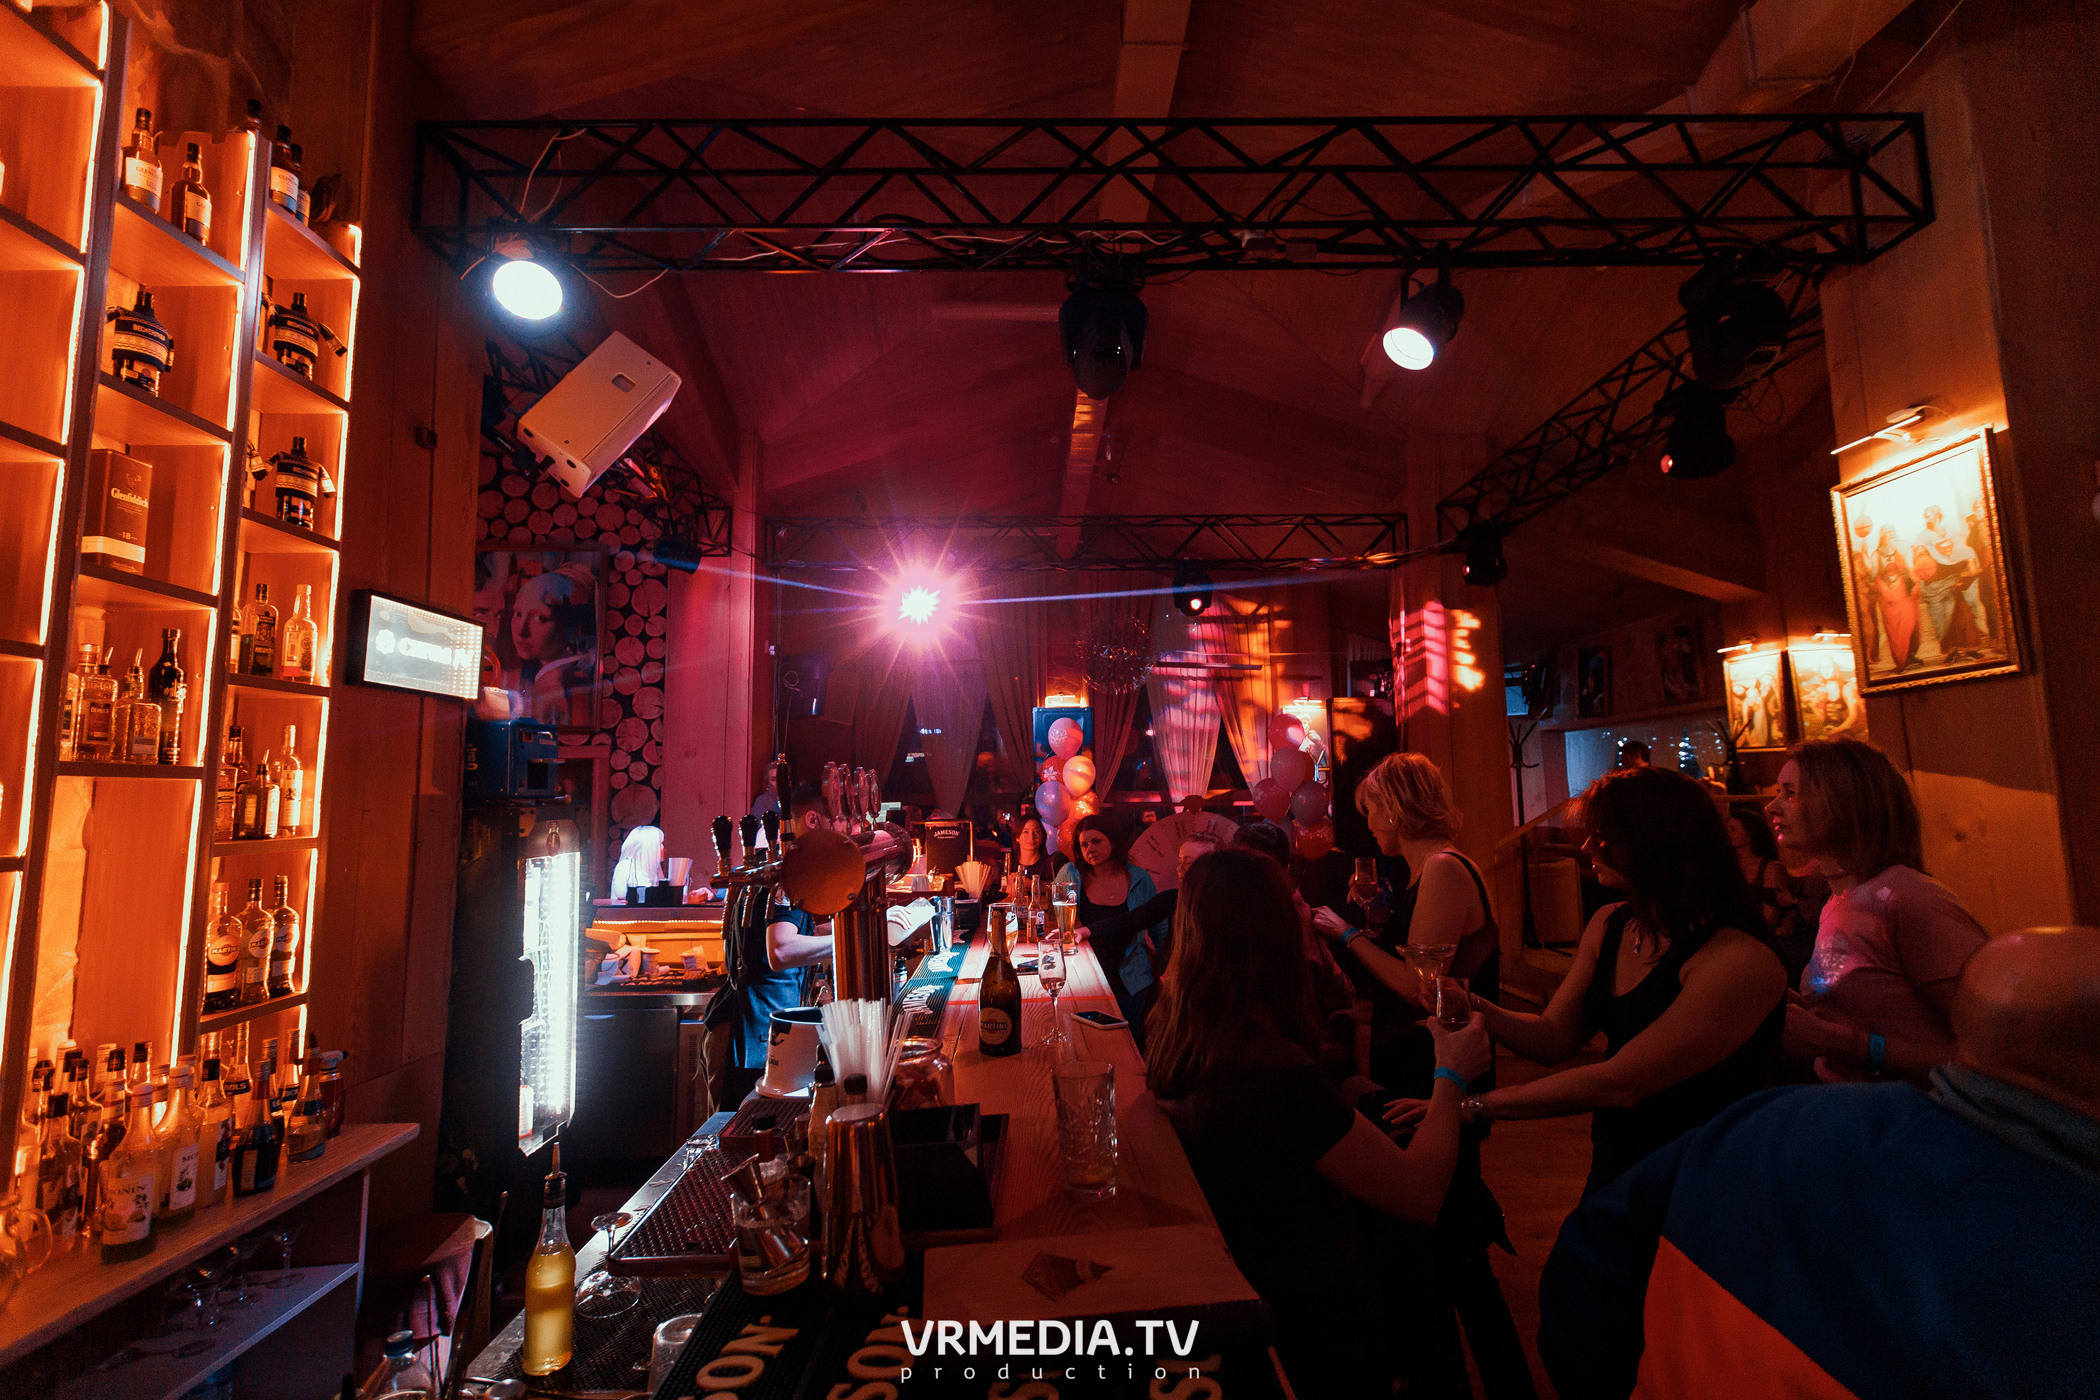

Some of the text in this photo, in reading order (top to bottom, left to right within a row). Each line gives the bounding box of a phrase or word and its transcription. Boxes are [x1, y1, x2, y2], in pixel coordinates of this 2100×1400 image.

[111, 487, 149, 508] Glenfiddich
[122, 531, 131, 540] 18
[934, 829, 960, 837] JAMESON
[980, 1020, 1008, 1032] MARTINI
[224, 1080, 247, 1092] BOLS
